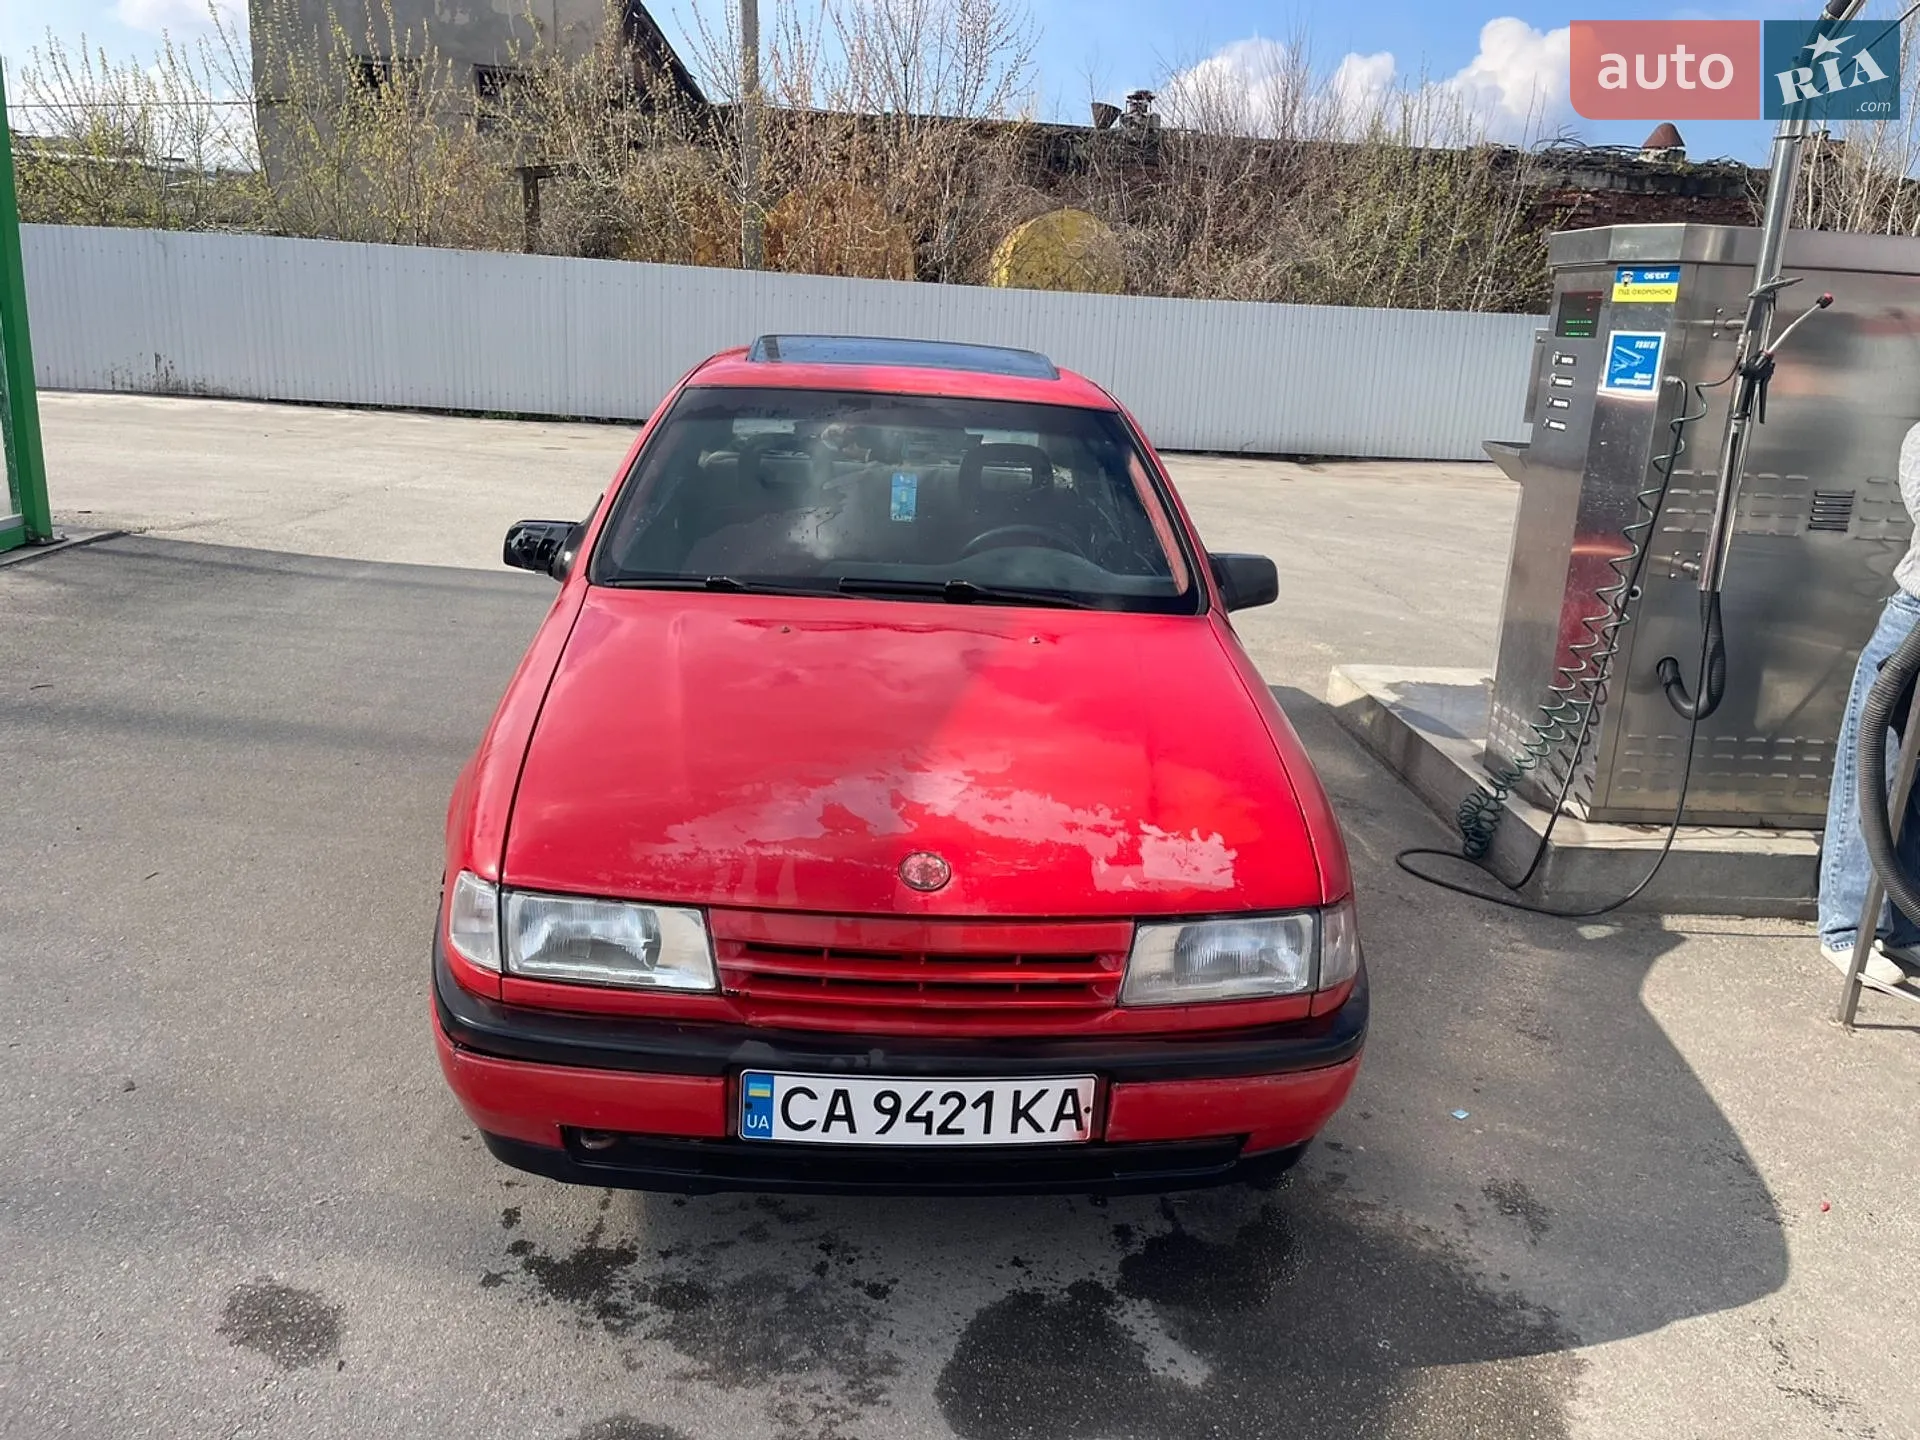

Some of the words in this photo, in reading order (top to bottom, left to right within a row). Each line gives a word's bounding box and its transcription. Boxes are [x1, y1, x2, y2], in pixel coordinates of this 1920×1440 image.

[747, 1114, 769, 1130] UA
[780, 1086, 857, 1134] CA
[873, 1090, 995, 1135] 9421
[1010, 1088, 1084, 1134] KA
